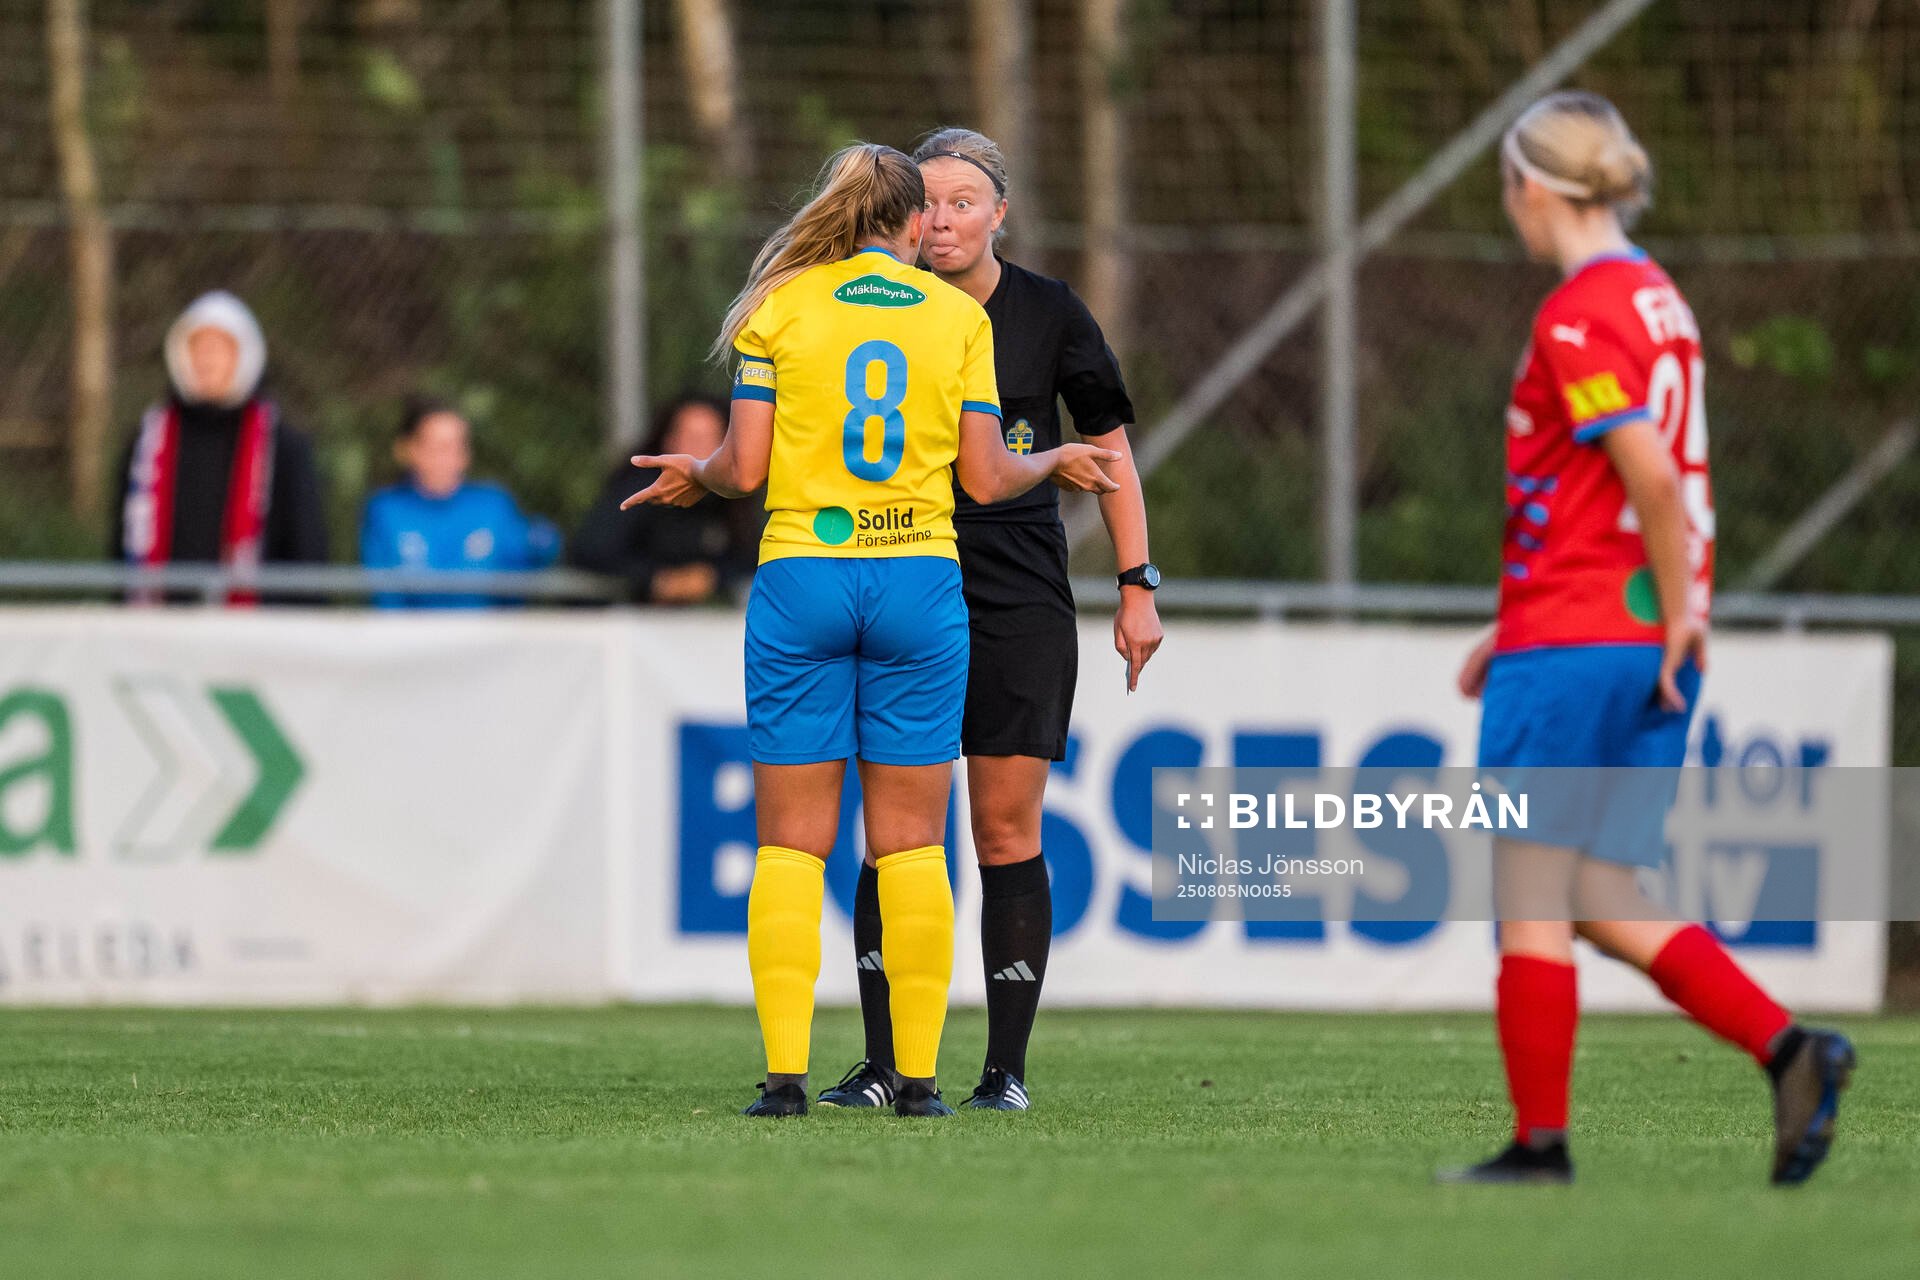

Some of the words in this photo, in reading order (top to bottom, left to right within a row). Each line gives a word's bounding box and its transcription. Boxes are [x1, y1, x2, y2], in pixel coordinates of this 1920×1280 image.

[846, 283, 914, 300] Mäklarbyrån
[744, 367, 777, 382] SPET
[843, 340, 908, 482] 8
[858, 507, 914, 531] Solid
[856, 529, 932, 547] Försäkring
[676, 720, 1452, 948] BSES
